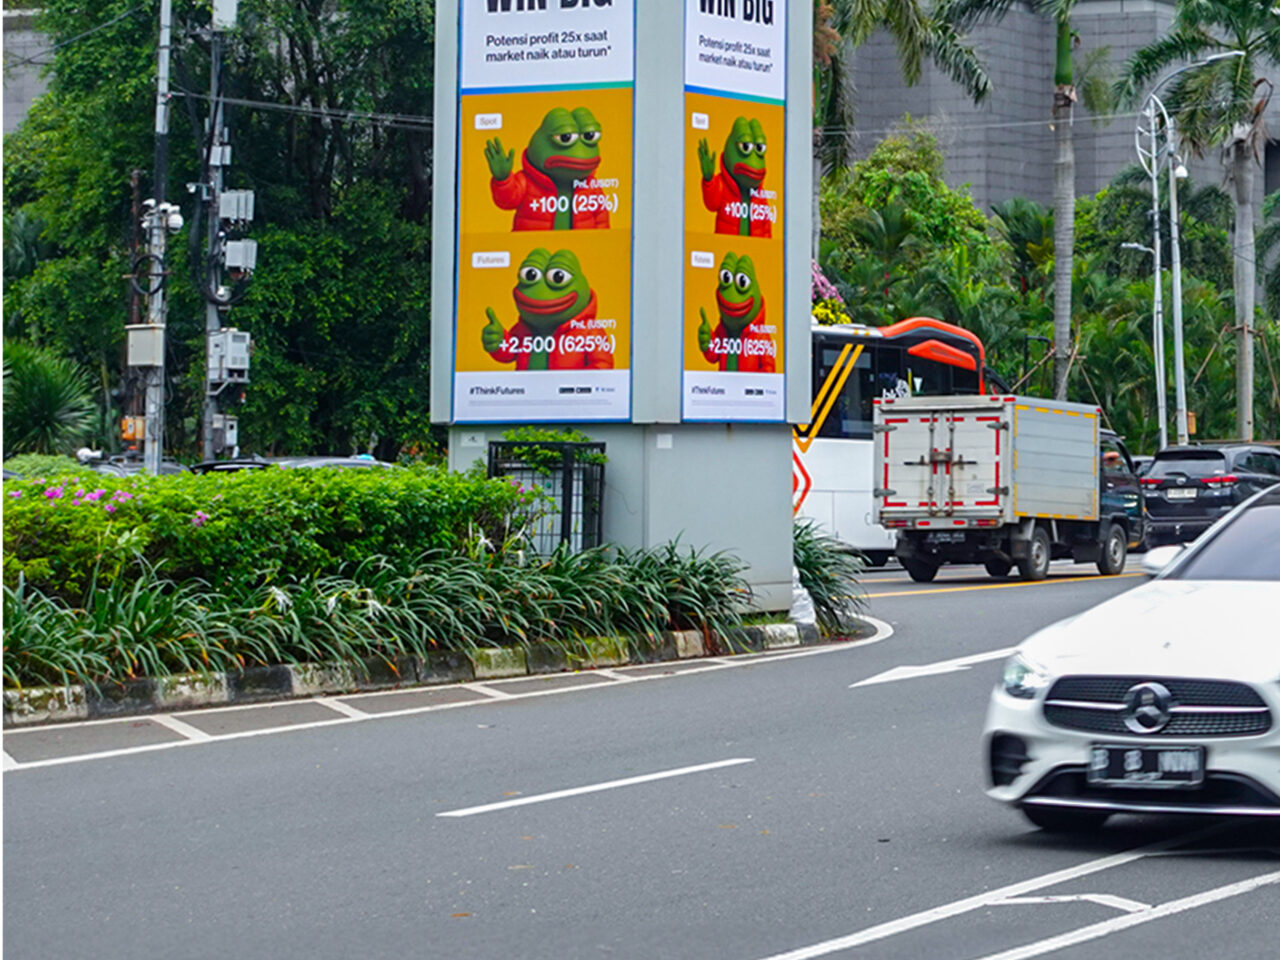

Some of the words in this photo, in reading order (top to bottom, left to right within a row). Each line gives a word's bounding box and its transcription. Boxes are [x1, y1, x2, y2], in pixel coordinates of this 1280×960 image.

[486, 33, 528, 46] Potensi
[529, 31, 559, 46] profit
[561, 31, 582, 43] 25x
[584, 30, 608, 41] saat
[486, 50, 524, 62] market
[526, 48, 549, 60] naik
[551, 48, 576, 59] atau
[529, 195, 569, 213] +100
[572, 193, 618, 214] (25%)
[725, 201, 748, 218] +100
[750, 202, 777, 223] (25%)
[499, 336, 555, 353] +2.500
[559, 334, 616, 355] (625%)
[708, 338, 742, 354] +2.500
[744, 338, 777, 358] (625%)
[470, 386, 525, 395] #ThinkFutures
